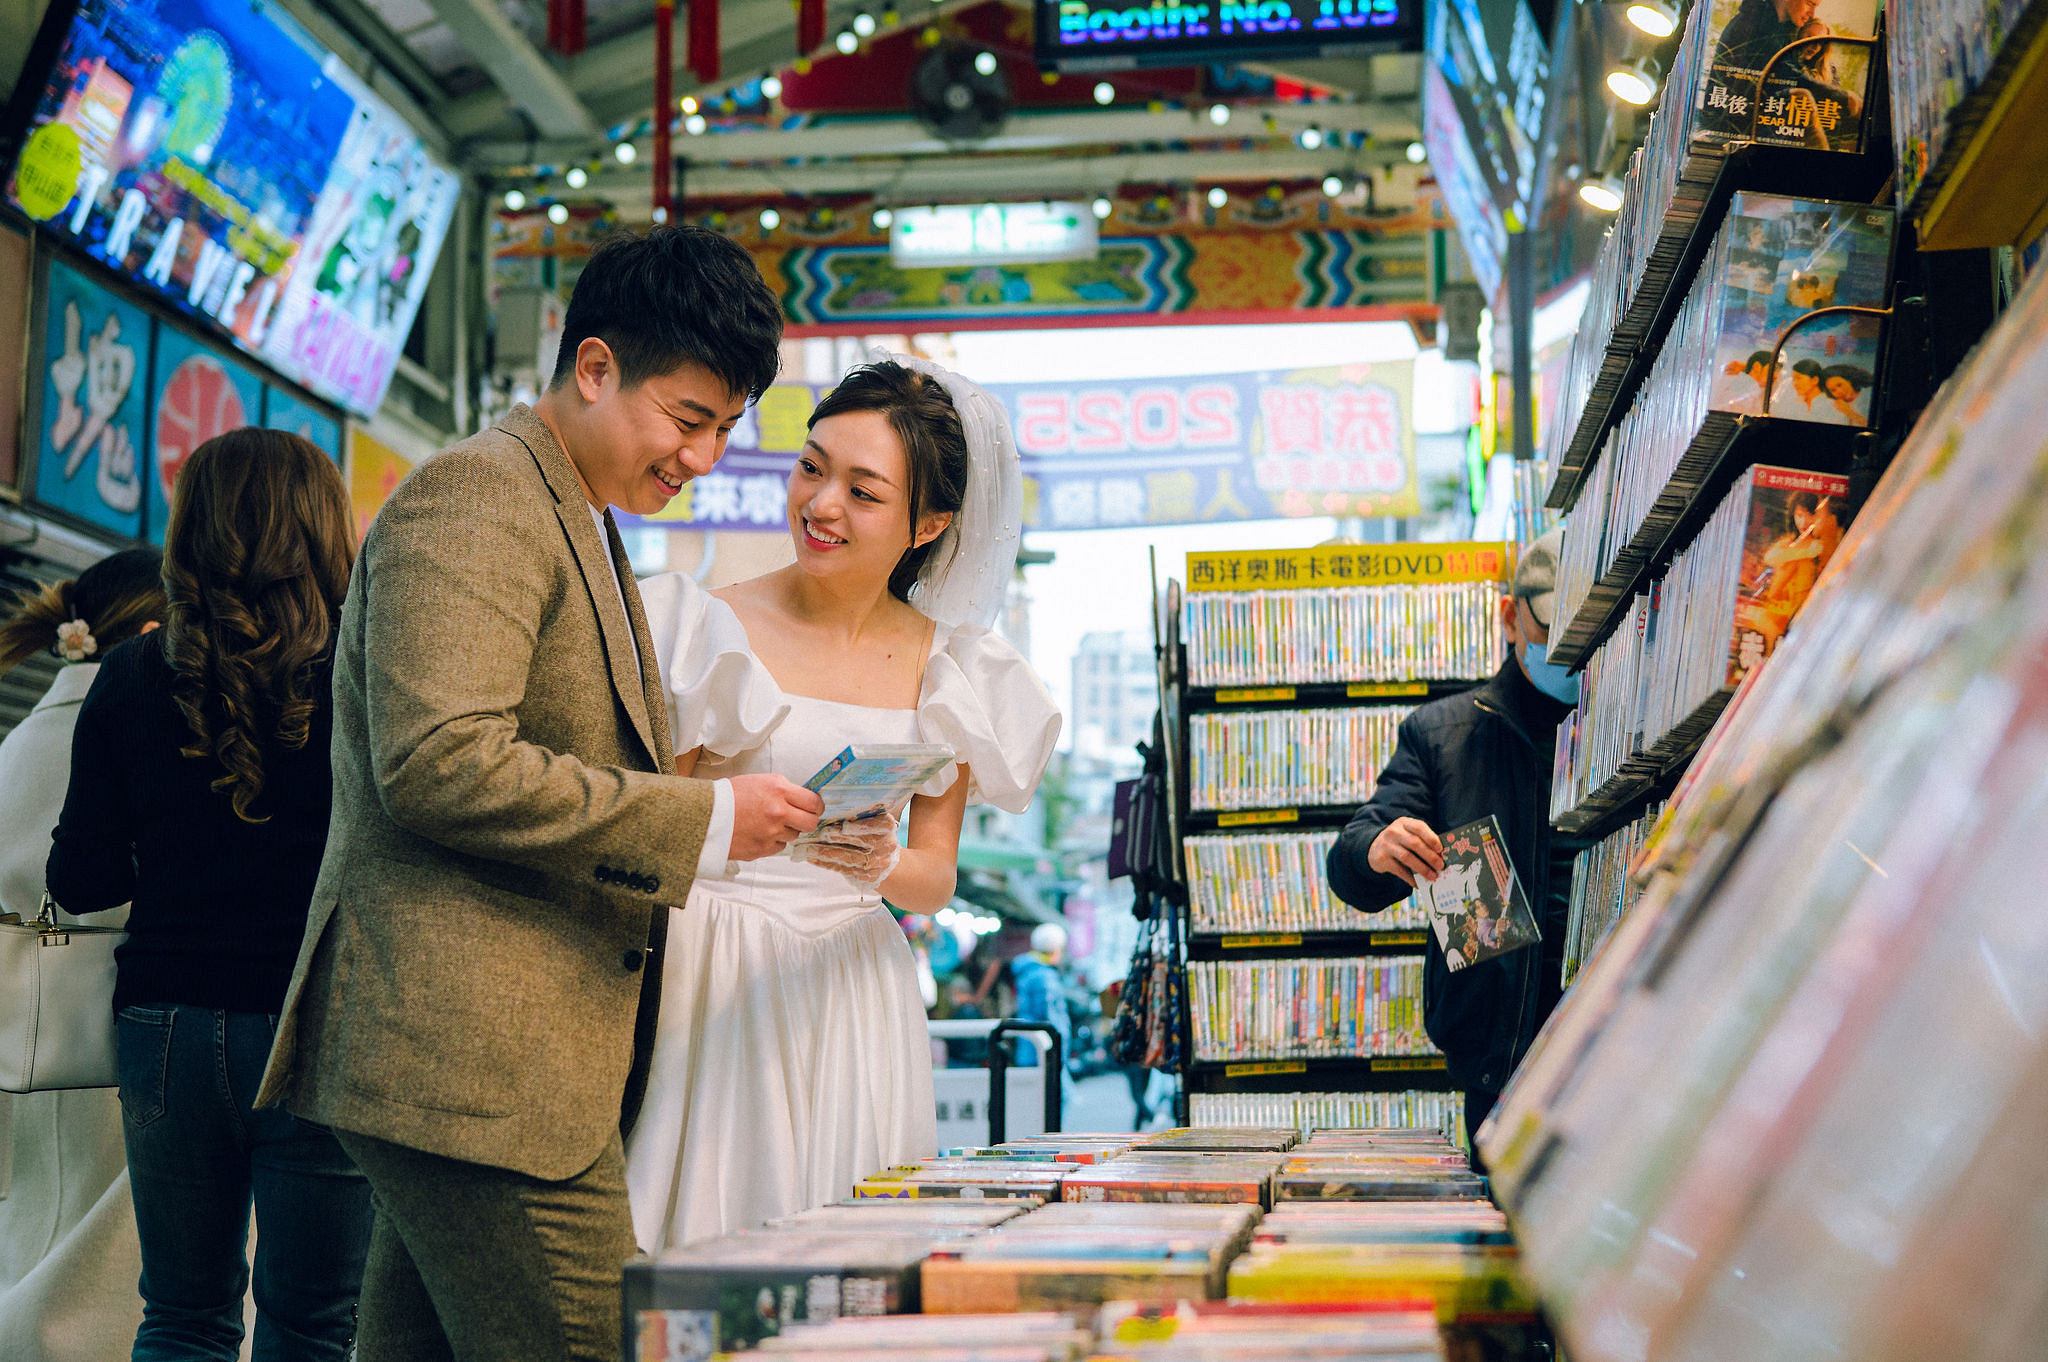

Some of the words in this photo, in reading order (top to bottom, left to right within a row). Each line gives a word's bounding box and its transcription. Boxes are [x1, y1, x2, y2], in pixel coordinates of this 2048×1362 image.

[1059, 0, 1210, 44] Booth:
[1220, 0, 1301, 33] No.
[1707, 86, 1843, 131] 最後一封情書
[1775, 126, 1805, 138] JOHN
[70, 163, 278, 343] TRAVEL
[1193, 551, 1498, 583] 西洋奧斯卡電影DVD特價
